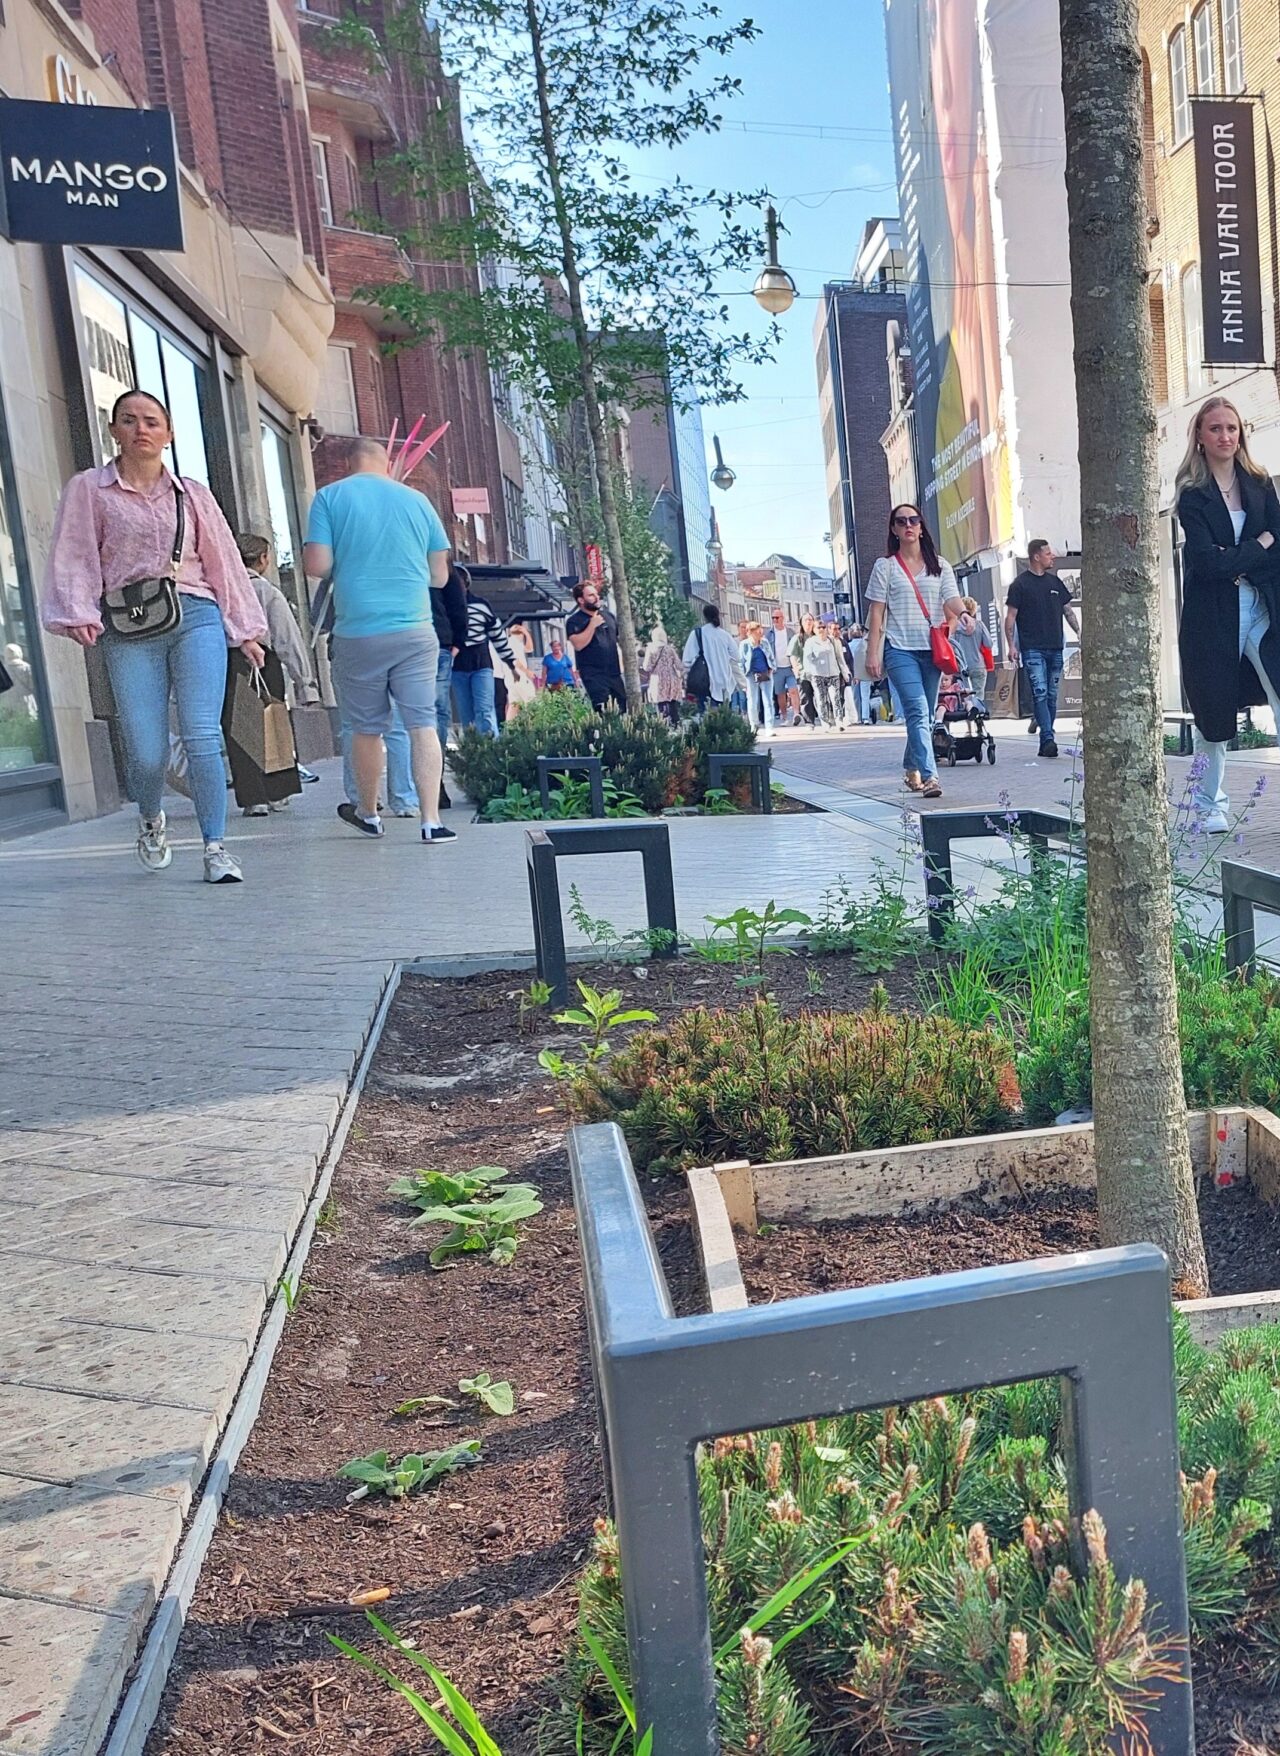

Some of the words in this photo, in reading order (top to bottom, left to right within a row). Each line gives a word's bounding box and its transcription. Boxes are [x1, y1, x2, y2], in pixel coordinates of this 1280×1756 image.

[10, 156, 168, 193] MANGO
[1212, 122, 1237, 194] TOOR
[66, 190, 120, 208] MAN
[1216, 203, 1240, 260] VAN
[1220, 269, 1245, 344] ANNA
